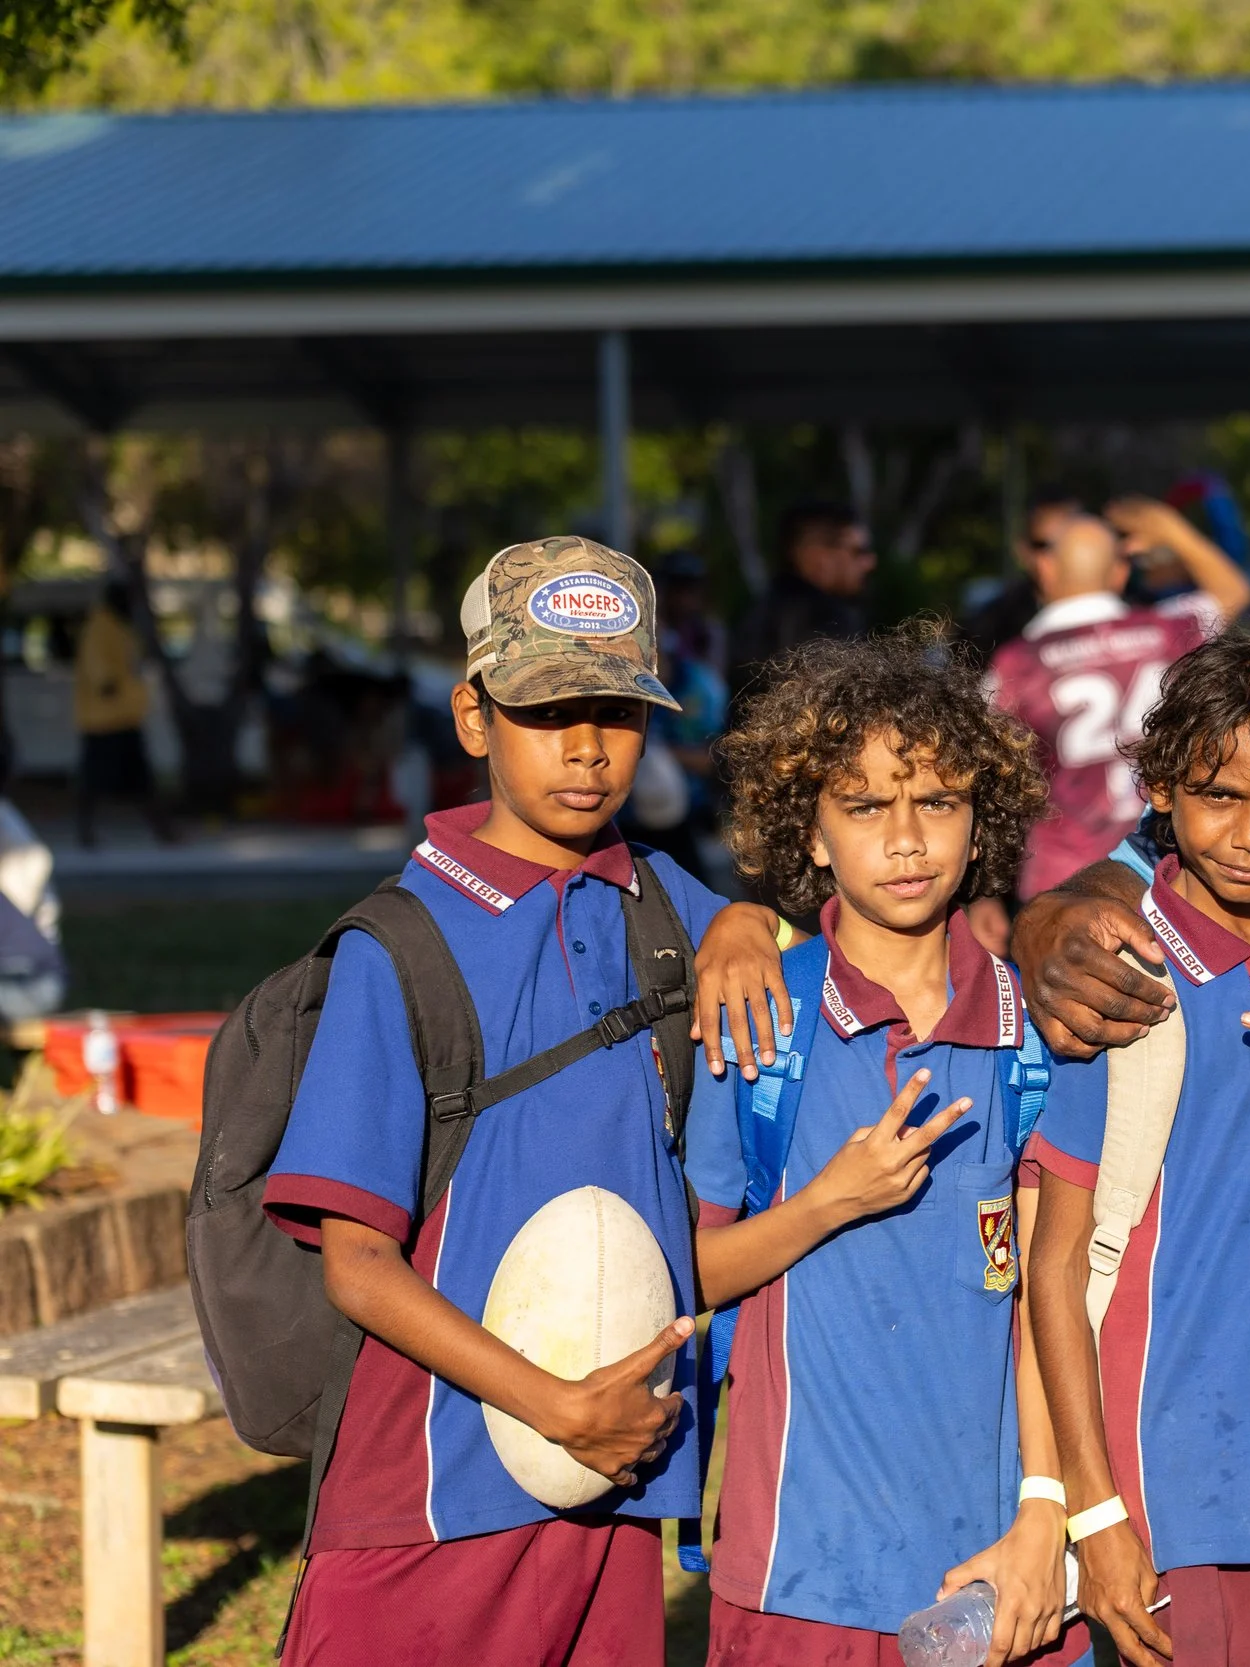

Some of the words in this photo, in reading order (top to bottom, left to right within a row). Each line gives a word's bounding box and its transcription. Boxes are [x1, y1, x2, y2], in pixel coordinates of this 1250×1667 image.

[560, 577, 612, 590] ESTABLISHED
[552, 593, 620, 613] RINGERS
[569, 609, 607, 618] Western
[579, 621, 601, 630] 2012
[428, 851, 503, 904] MAREEBA
[1148, 909, 1205, 977] MAREEBA
[995, 963, 1014, 1037] MAREEBA
